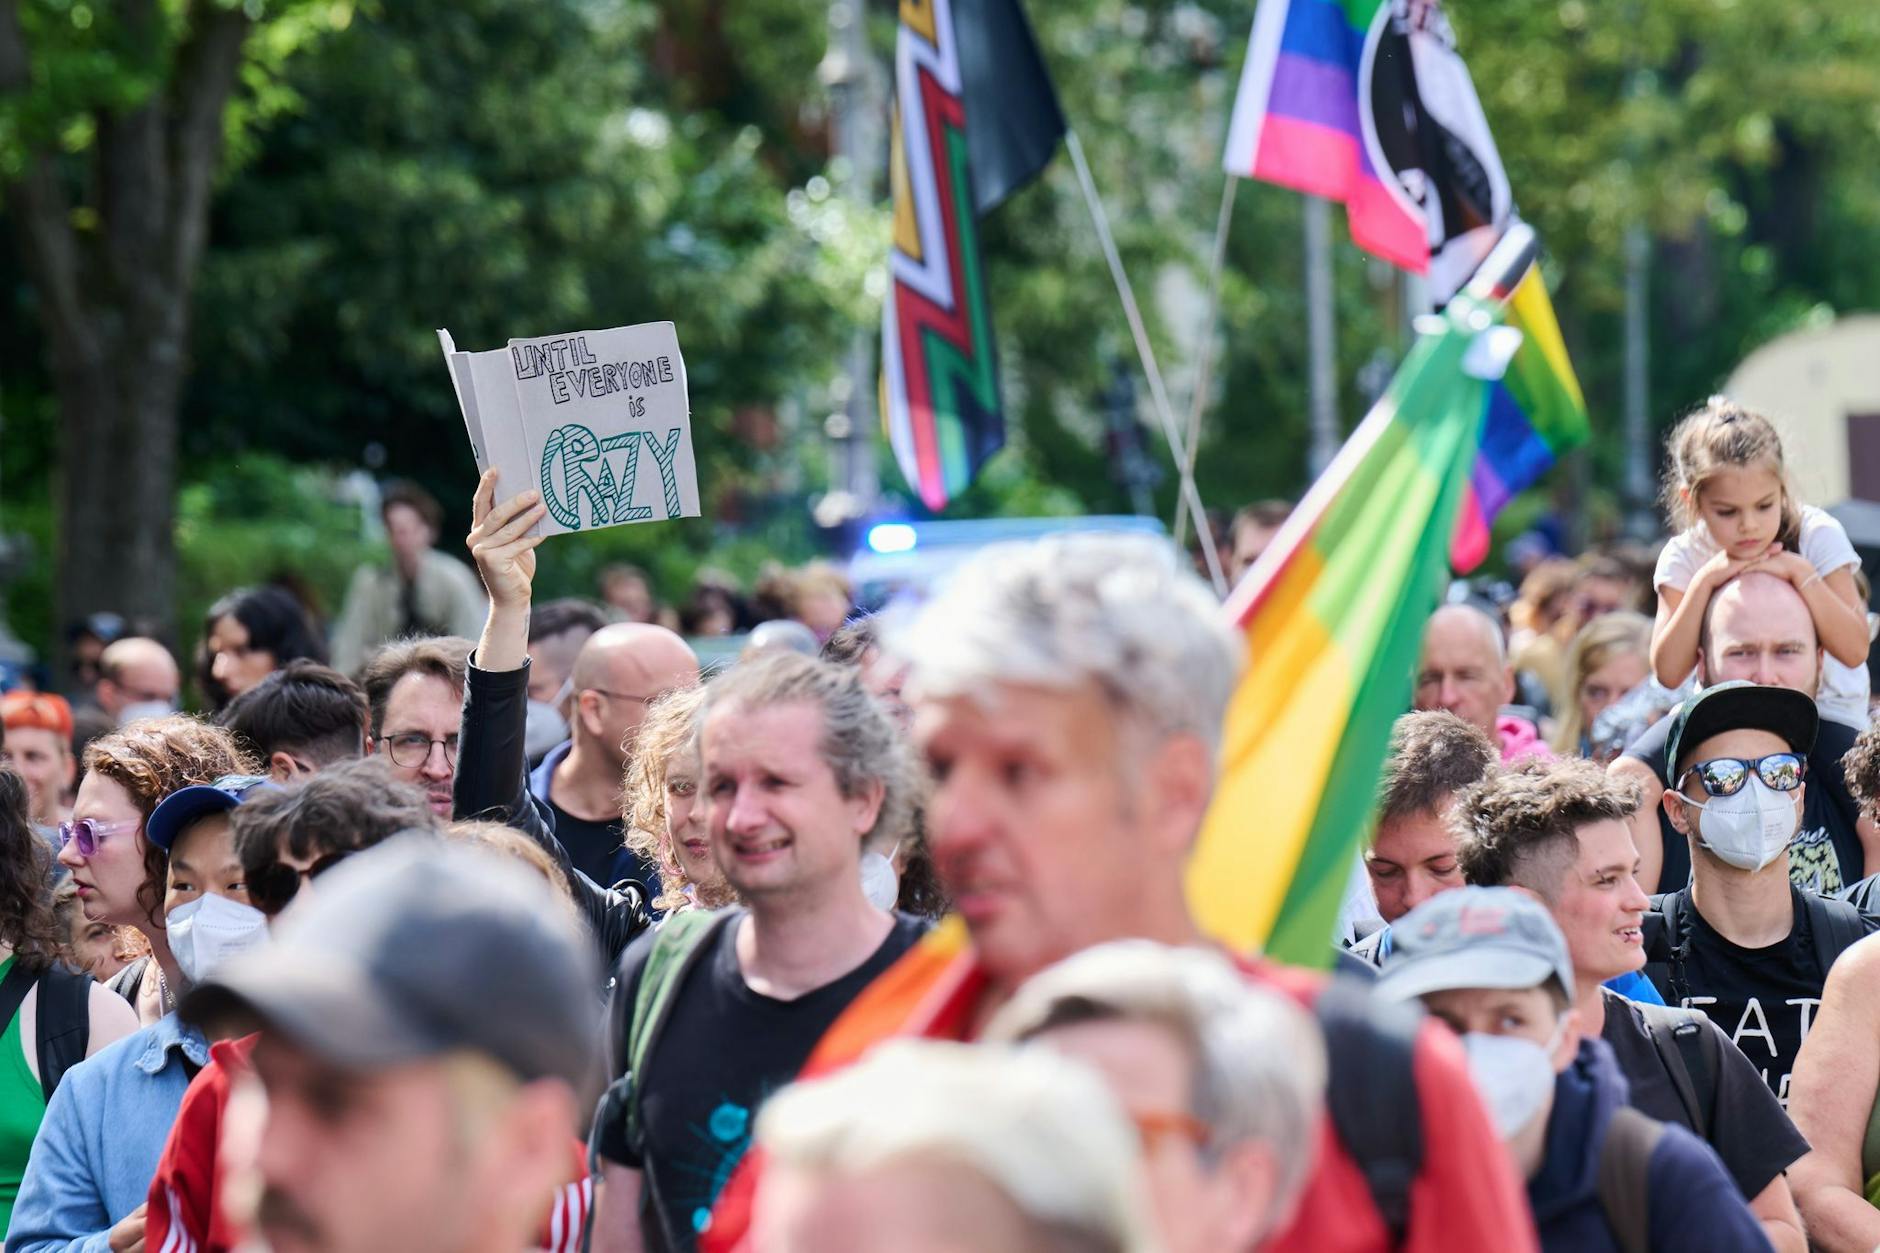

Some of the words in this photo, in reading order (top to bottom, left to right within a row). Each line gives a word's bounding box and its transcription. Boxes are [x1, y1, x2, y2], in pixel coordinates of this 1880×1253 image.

[511, 336, 596, 380] UNTIL
[549, 356, 674, 404] EVERYONE
[628, 395, 646, 417] is
[540, 423, 682, 530] CRAZY
